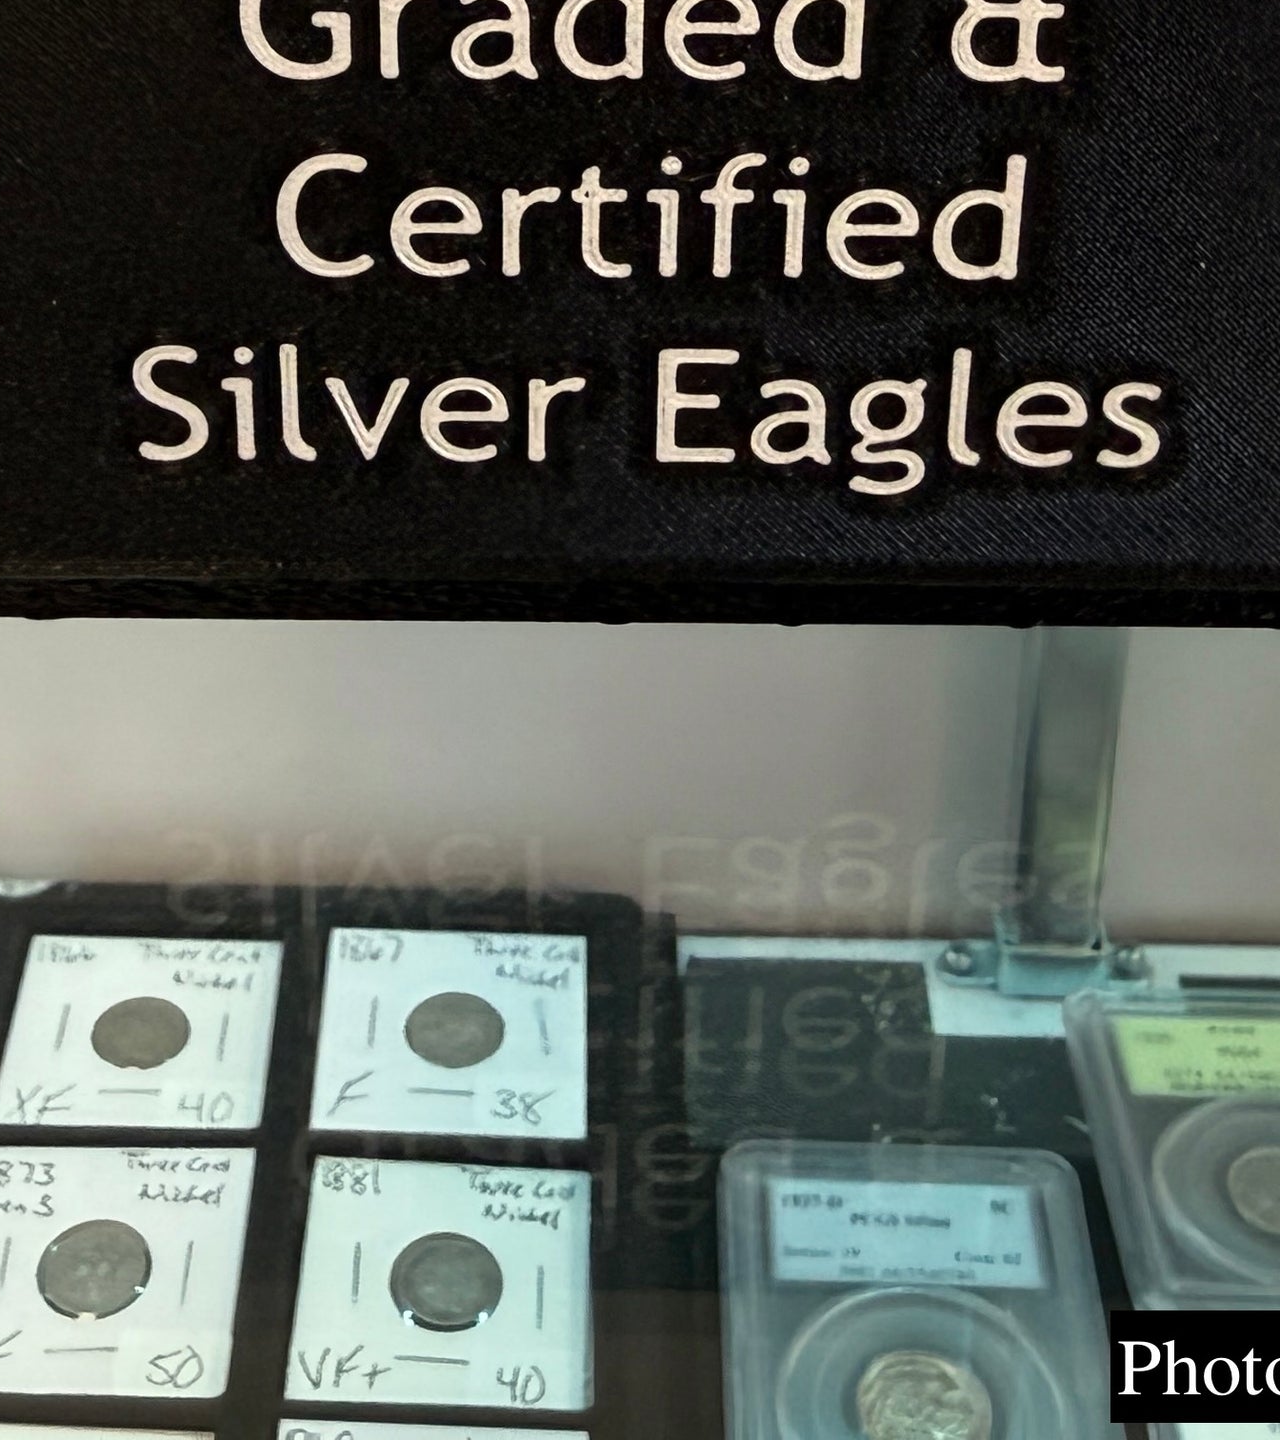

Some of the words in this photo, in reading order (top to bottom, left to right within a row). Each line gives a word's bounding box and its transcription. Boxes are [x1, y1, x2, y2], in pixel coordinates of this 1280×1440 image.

[275, 152, 1029, 279] Certified
[131, 343, 587, 463] Silver
[656, 347, 1163, 496] Eagles
[177, 1090, 236, 1123] 40
[489, 1088, 556, 1126] 38
[145, 1344, 206, 1390] 50
[496, 1364, 547, 1406] 40
